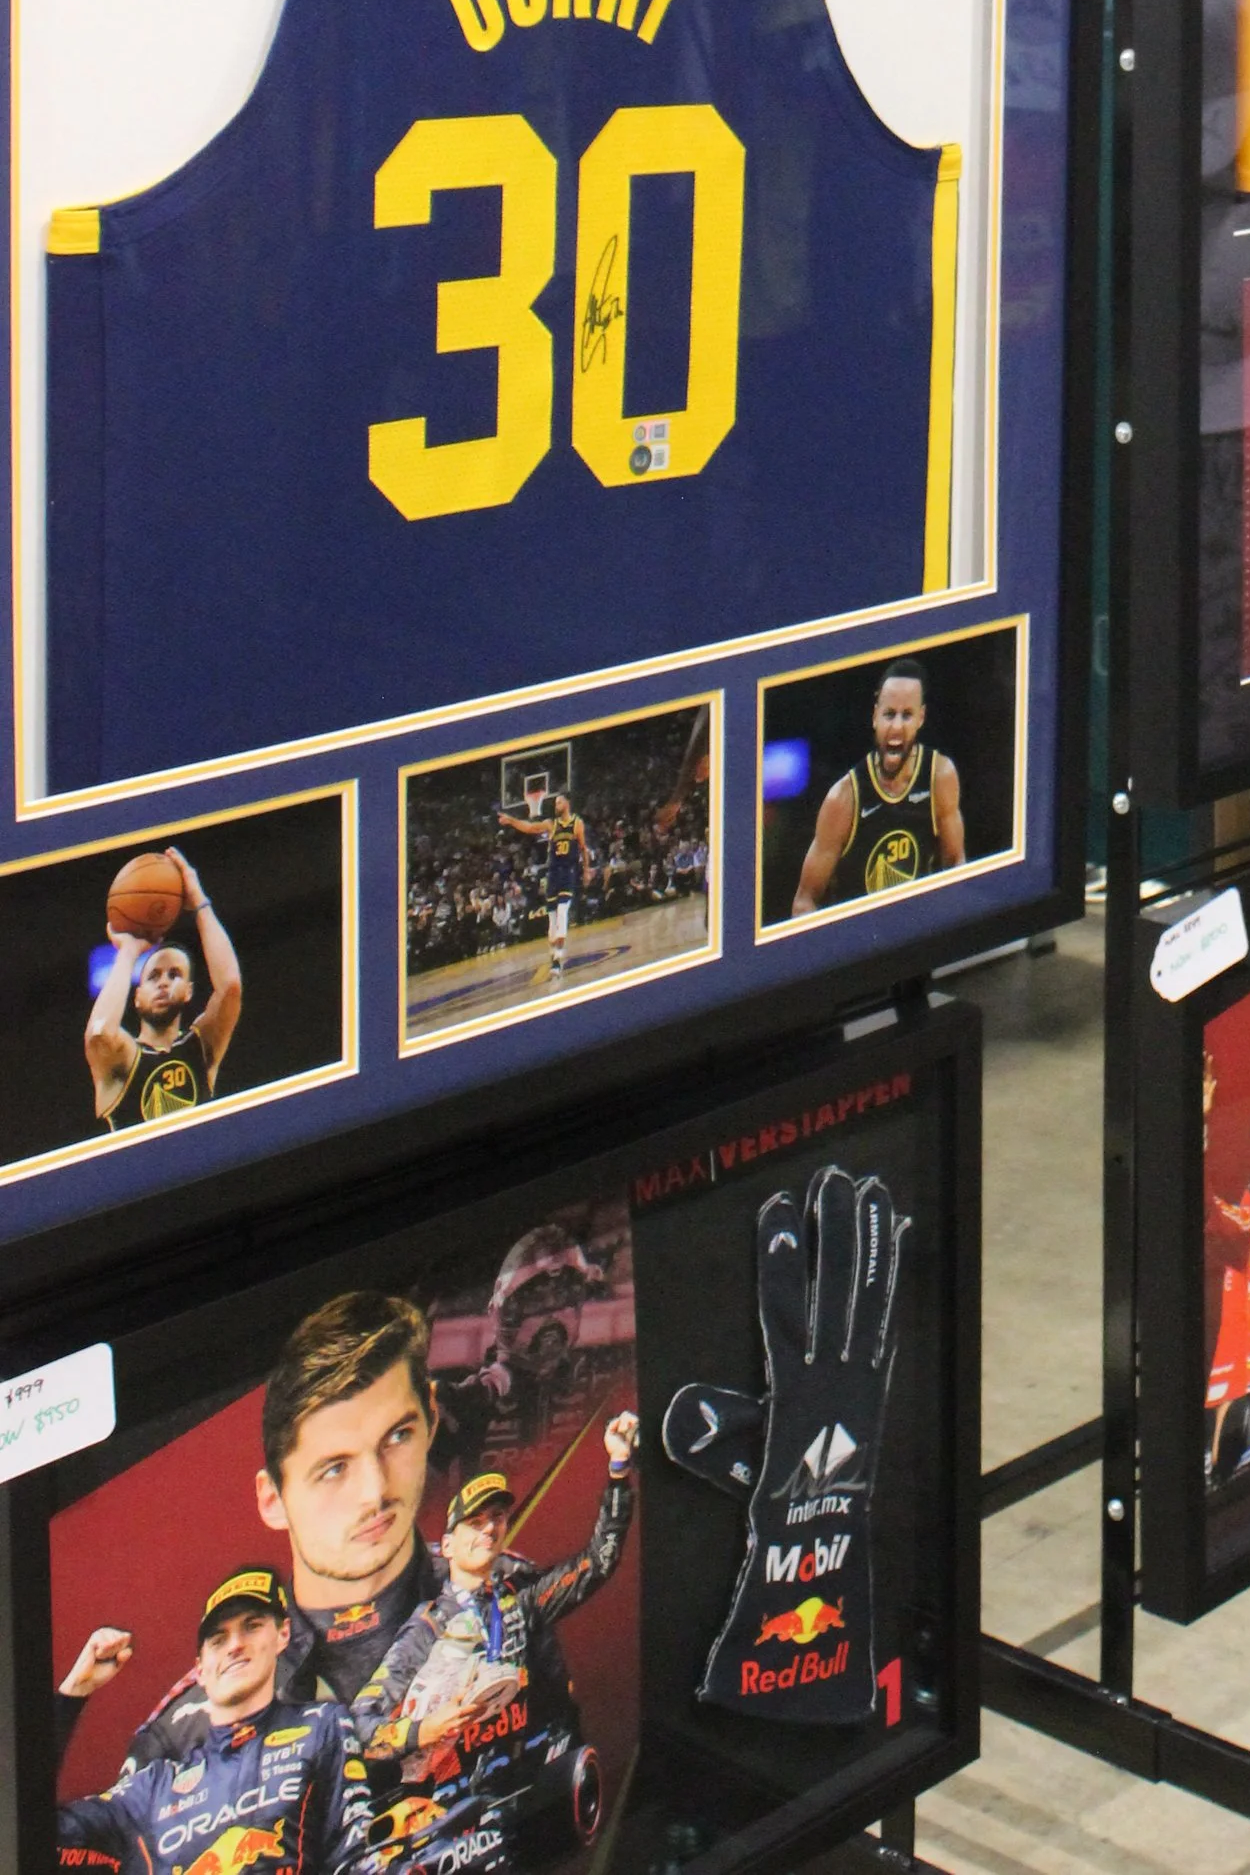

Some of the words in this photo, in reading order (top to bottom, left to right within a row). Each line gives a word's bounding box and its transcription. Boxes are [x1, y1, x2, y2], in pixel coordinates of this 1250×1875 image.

[368, 102, 747, 522] 30
[887, 836, 910, 863] 30
[162, 1065, 186, 1092] 30
[34, 1397, 81, 1435] $950
[785, 1493, 854, 1526] inter.mx
[765, 1533, 852, 1584] Mobil
[740, 1655, 800, 1696] Red
[800, 1640, 850, 1685] Bull
[876, 1657, 902, 1728] 1
[261, 1742, 306, 1766] BYBIT
[157, 1776, 304, 1855] ORACLE
